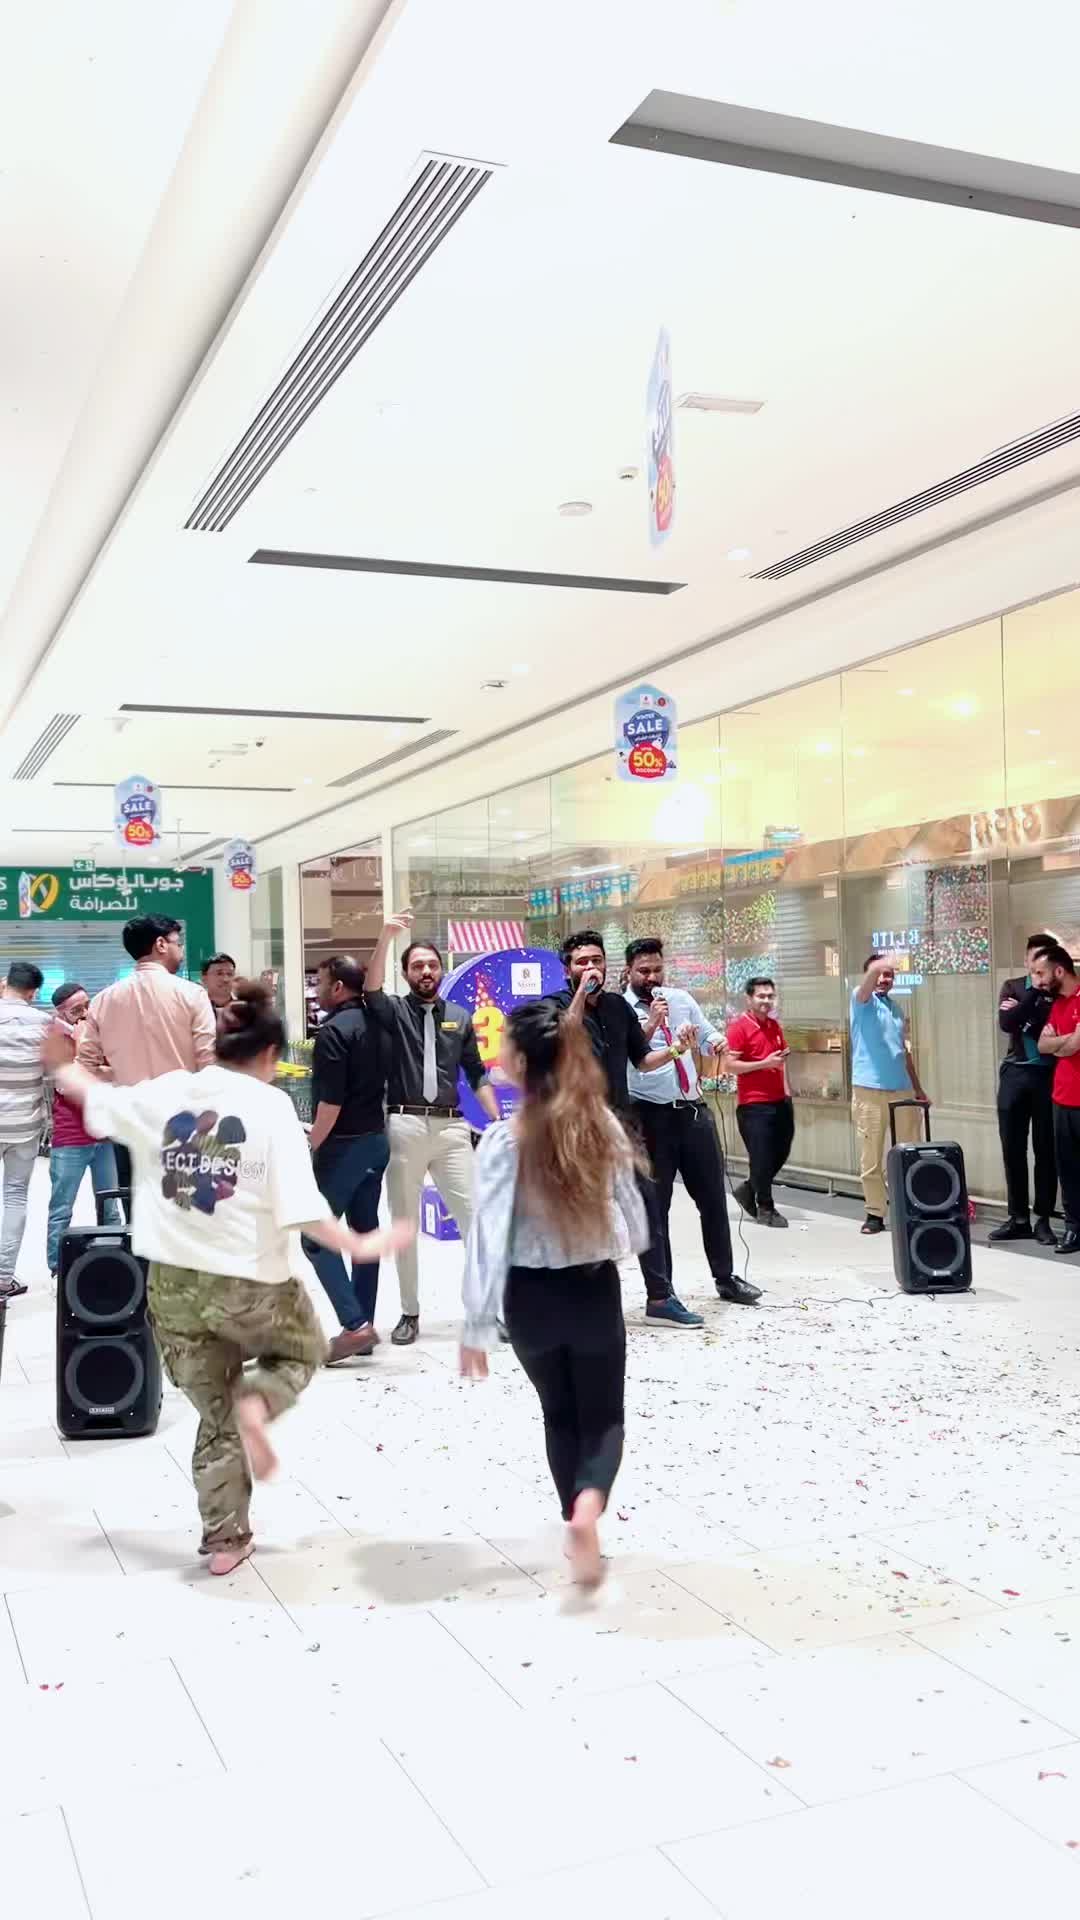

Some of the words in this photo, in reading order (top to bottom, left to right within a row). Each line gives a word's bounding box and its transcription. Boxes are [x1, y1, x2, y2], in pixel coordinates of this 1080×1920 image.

[627, 719, 663, 735] SALE
[634, 751, 662, 767] 50%
[124, 801, 151, 813] SALE
[69, 895, 138, 913] للصرافة
